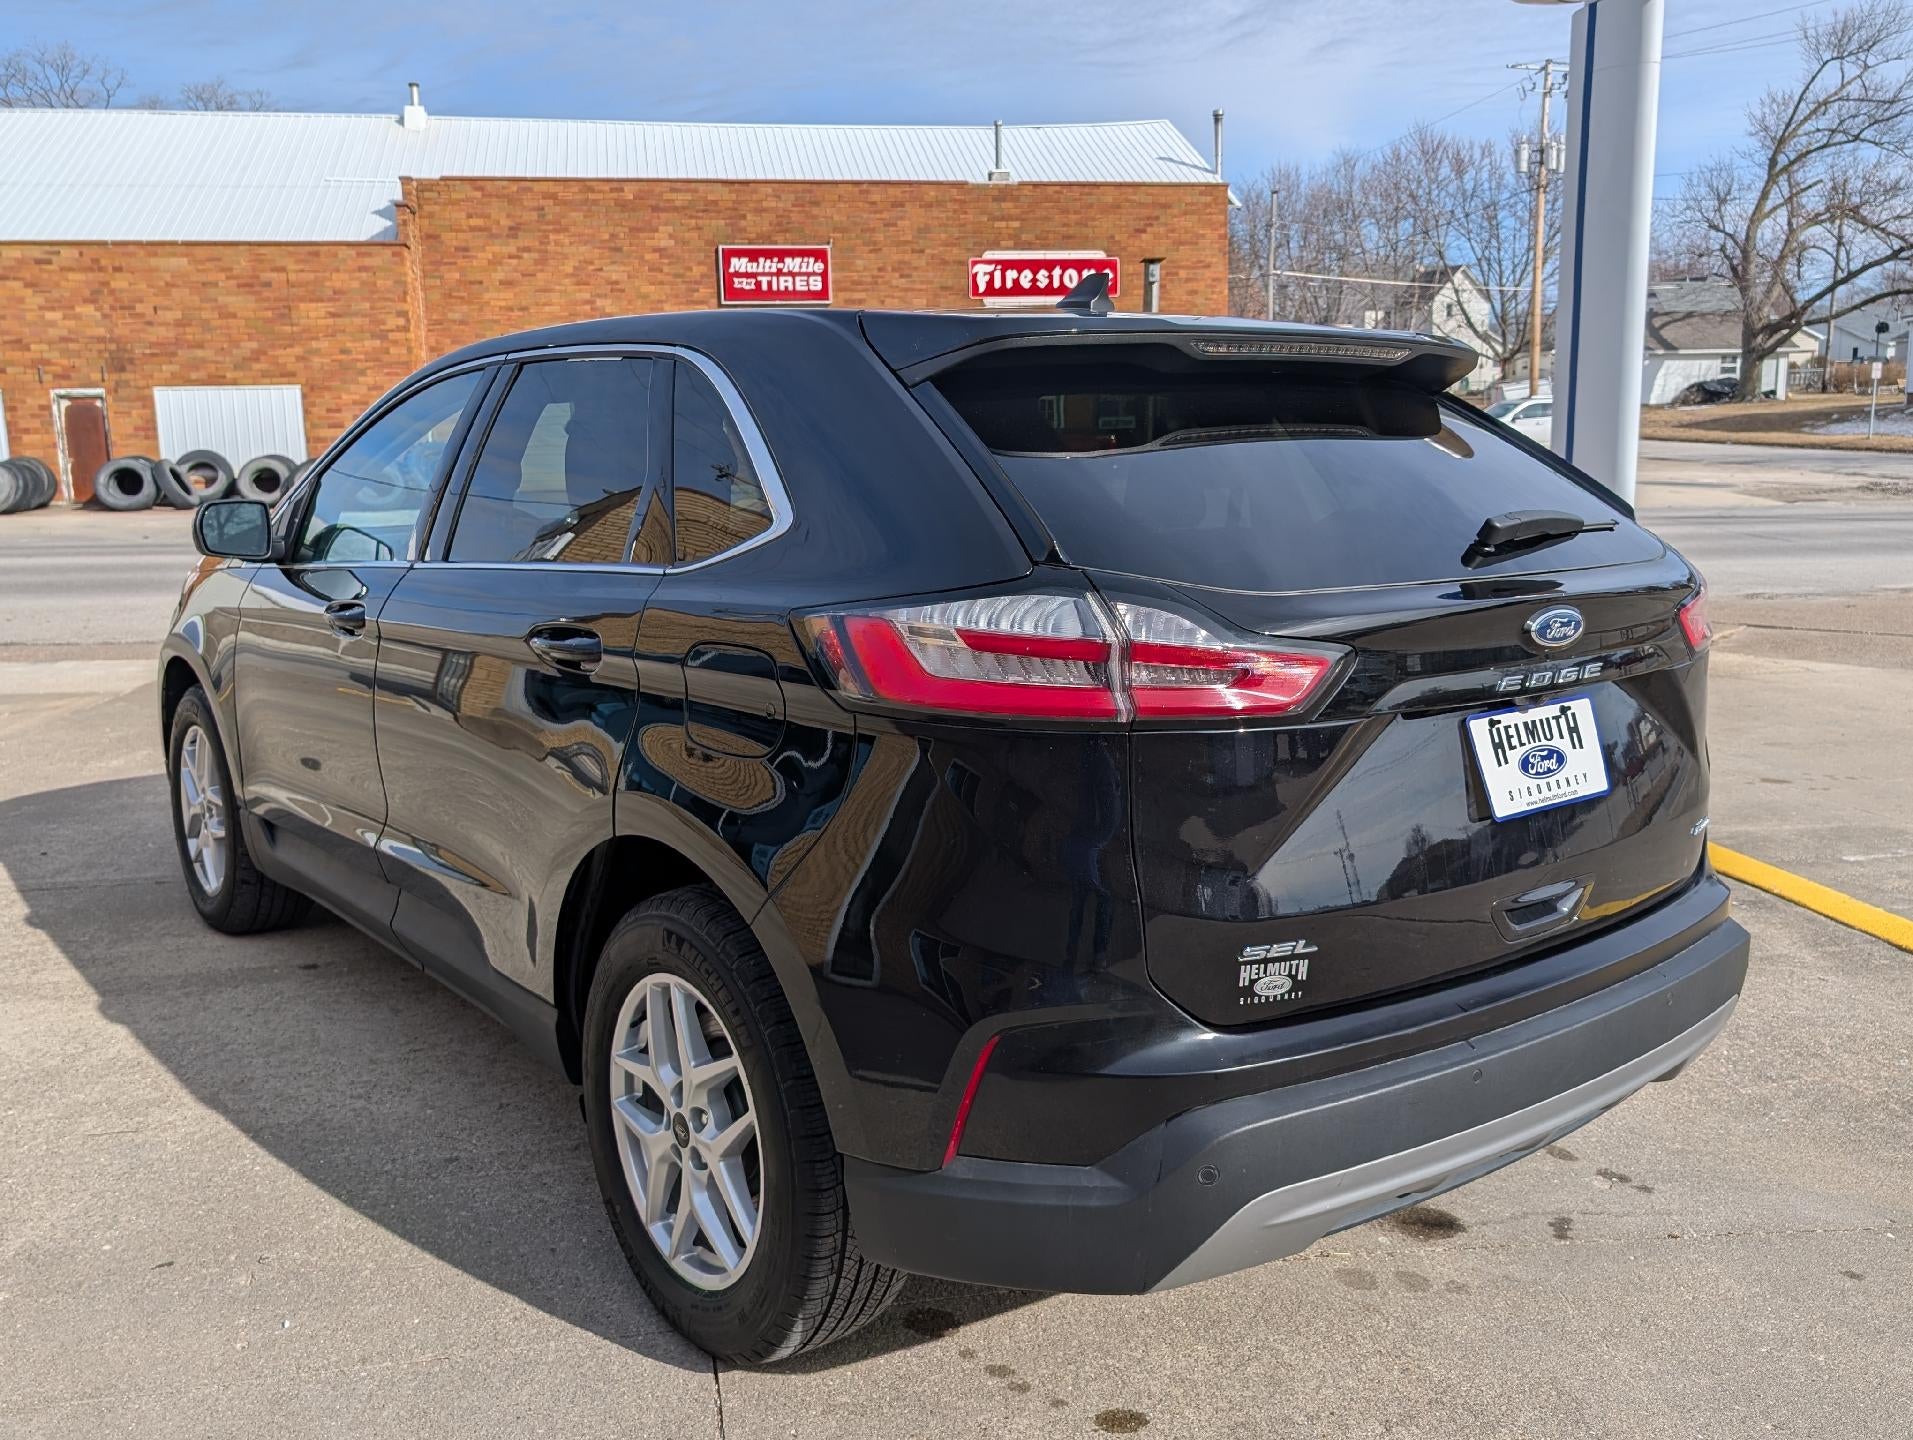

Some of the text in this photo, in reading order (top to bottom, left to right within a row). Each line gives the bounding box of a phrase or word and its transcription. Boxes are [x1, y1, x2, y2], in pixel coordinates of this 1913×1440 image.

[728, 256, 825, 273] Multi-Mile
[756, 275, 823, 292] TIRES
[1546, 618, 1576, 639] Ford
[1496, 662, 1604, 692] EDGE
[1488, 711, 1584, 767] HELMUTH
[1528, 750, 1559, 775] Ford
[1508, 772, 1589, 801] SIGOURNEY
[1525, 789, 1579, 807] www.helmuthford.com
[1237, 939, 1319, 962] SEL
[1238, 959, 1309, 987] HELMUTH
